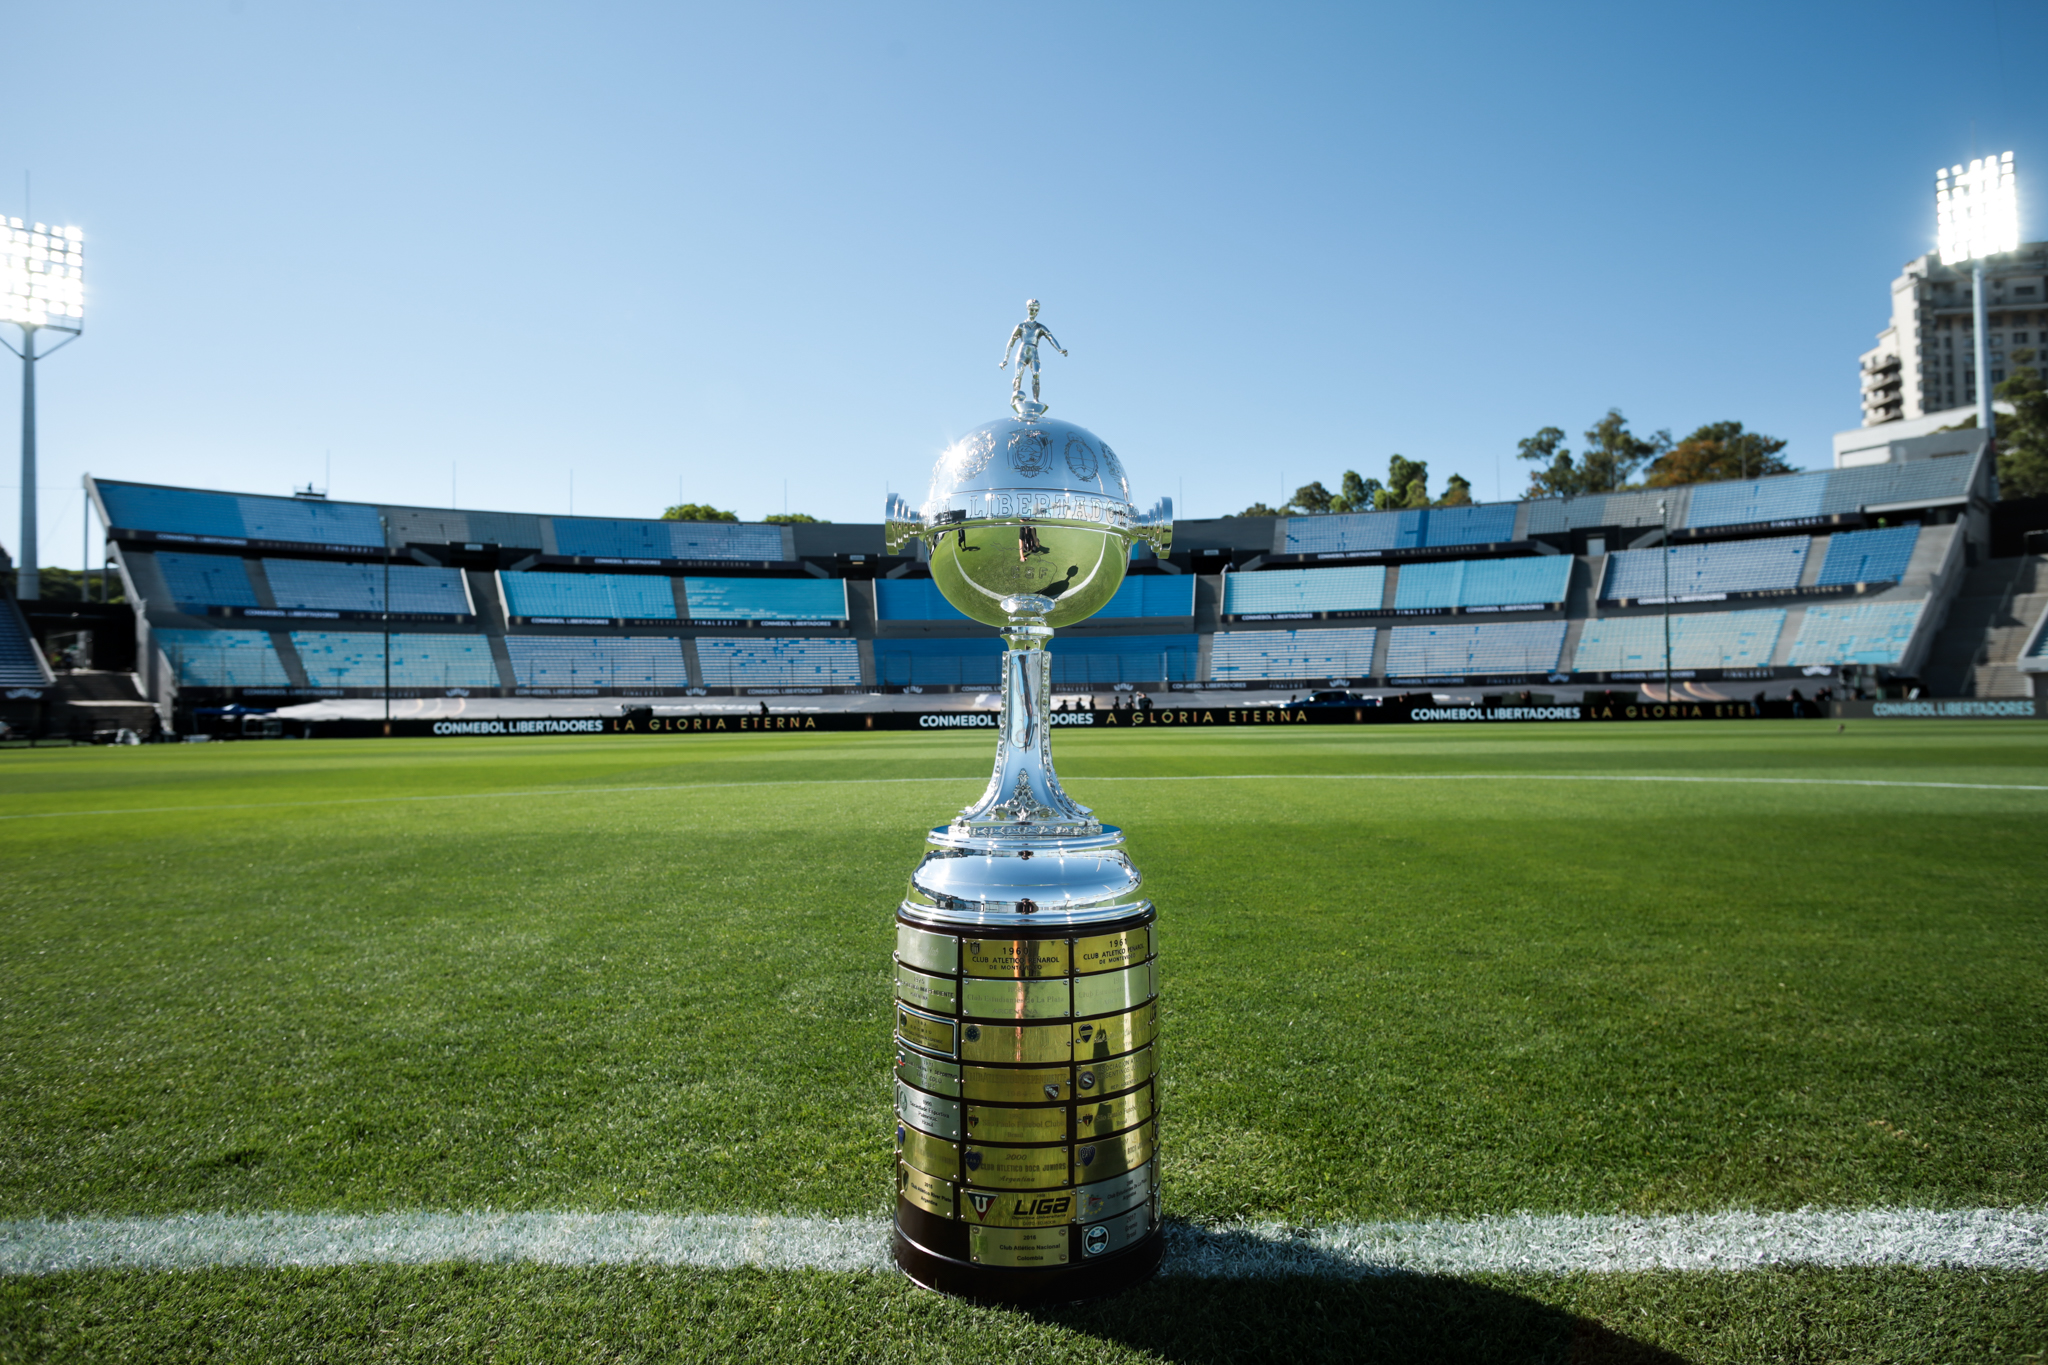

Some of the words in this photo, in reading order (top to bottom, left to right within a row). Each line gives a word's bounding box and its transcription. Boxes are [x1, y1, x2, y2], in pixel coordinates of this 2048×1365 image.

[1411, 708, 1485, 721] CONMEBOL
[1486, 706, 1581, 720] LIBERTADORES
[1590, 706, 1612, 718] LA
[1626, 706, 1702, 718] GLORIA
[1873, 702, 1936, 716] CONMEBOL
[1938, 700, 2036, 716] LIBERTADORES
[434, 721, 507, 734] CONMEBOL
[508, 720, 603, 733] LIBERTADORES
[614, 720, 635, 731] LA
[649, 718, 726, 730] GLORIA
[740, 716, 816, 729] ETERNA
[919, 714, 994, 727] CONMEBOL
[1106, 712, 1117, 724] A
[1132, 709, 1214, 724] GLÓRIA
[1229, 710, 1307, 722] ETERNA
[1083, 952, 1099, 960] CLUB
[1102, 948, 1126, 958] ATLETICO
[996, 1164, 1022, 1172] ATLETICO
[1042, 1162, 1066, 1172] JUNIORS
[930, 1191, 940, 1200] River
[974, 1196, 988, 1212] U
